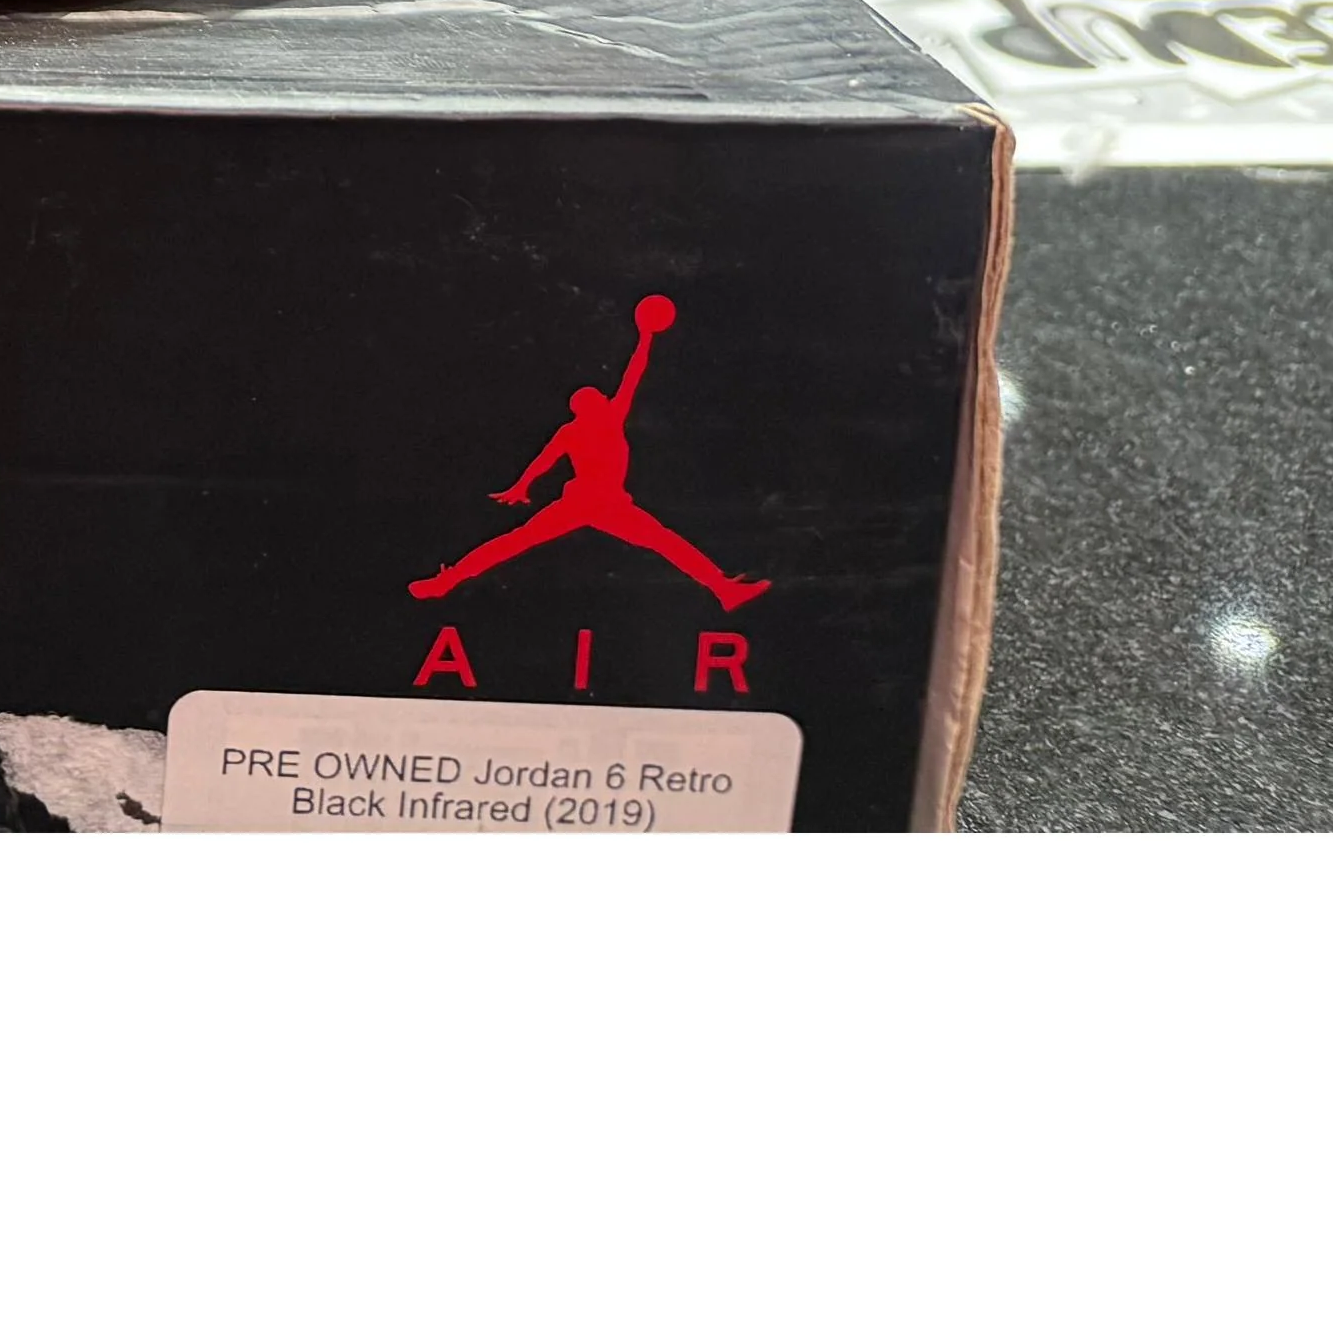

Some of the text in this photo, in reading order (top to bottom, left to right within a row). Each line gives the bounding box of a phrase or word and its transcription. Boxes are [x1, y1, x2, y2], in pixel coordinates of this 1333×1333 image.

[412, 625, 749, 693] AIR
[220, 746, 734, 795] PRE OWNED Jordan 6 Retro
[291, 785, 657, 833] Black Infrared (2019)
